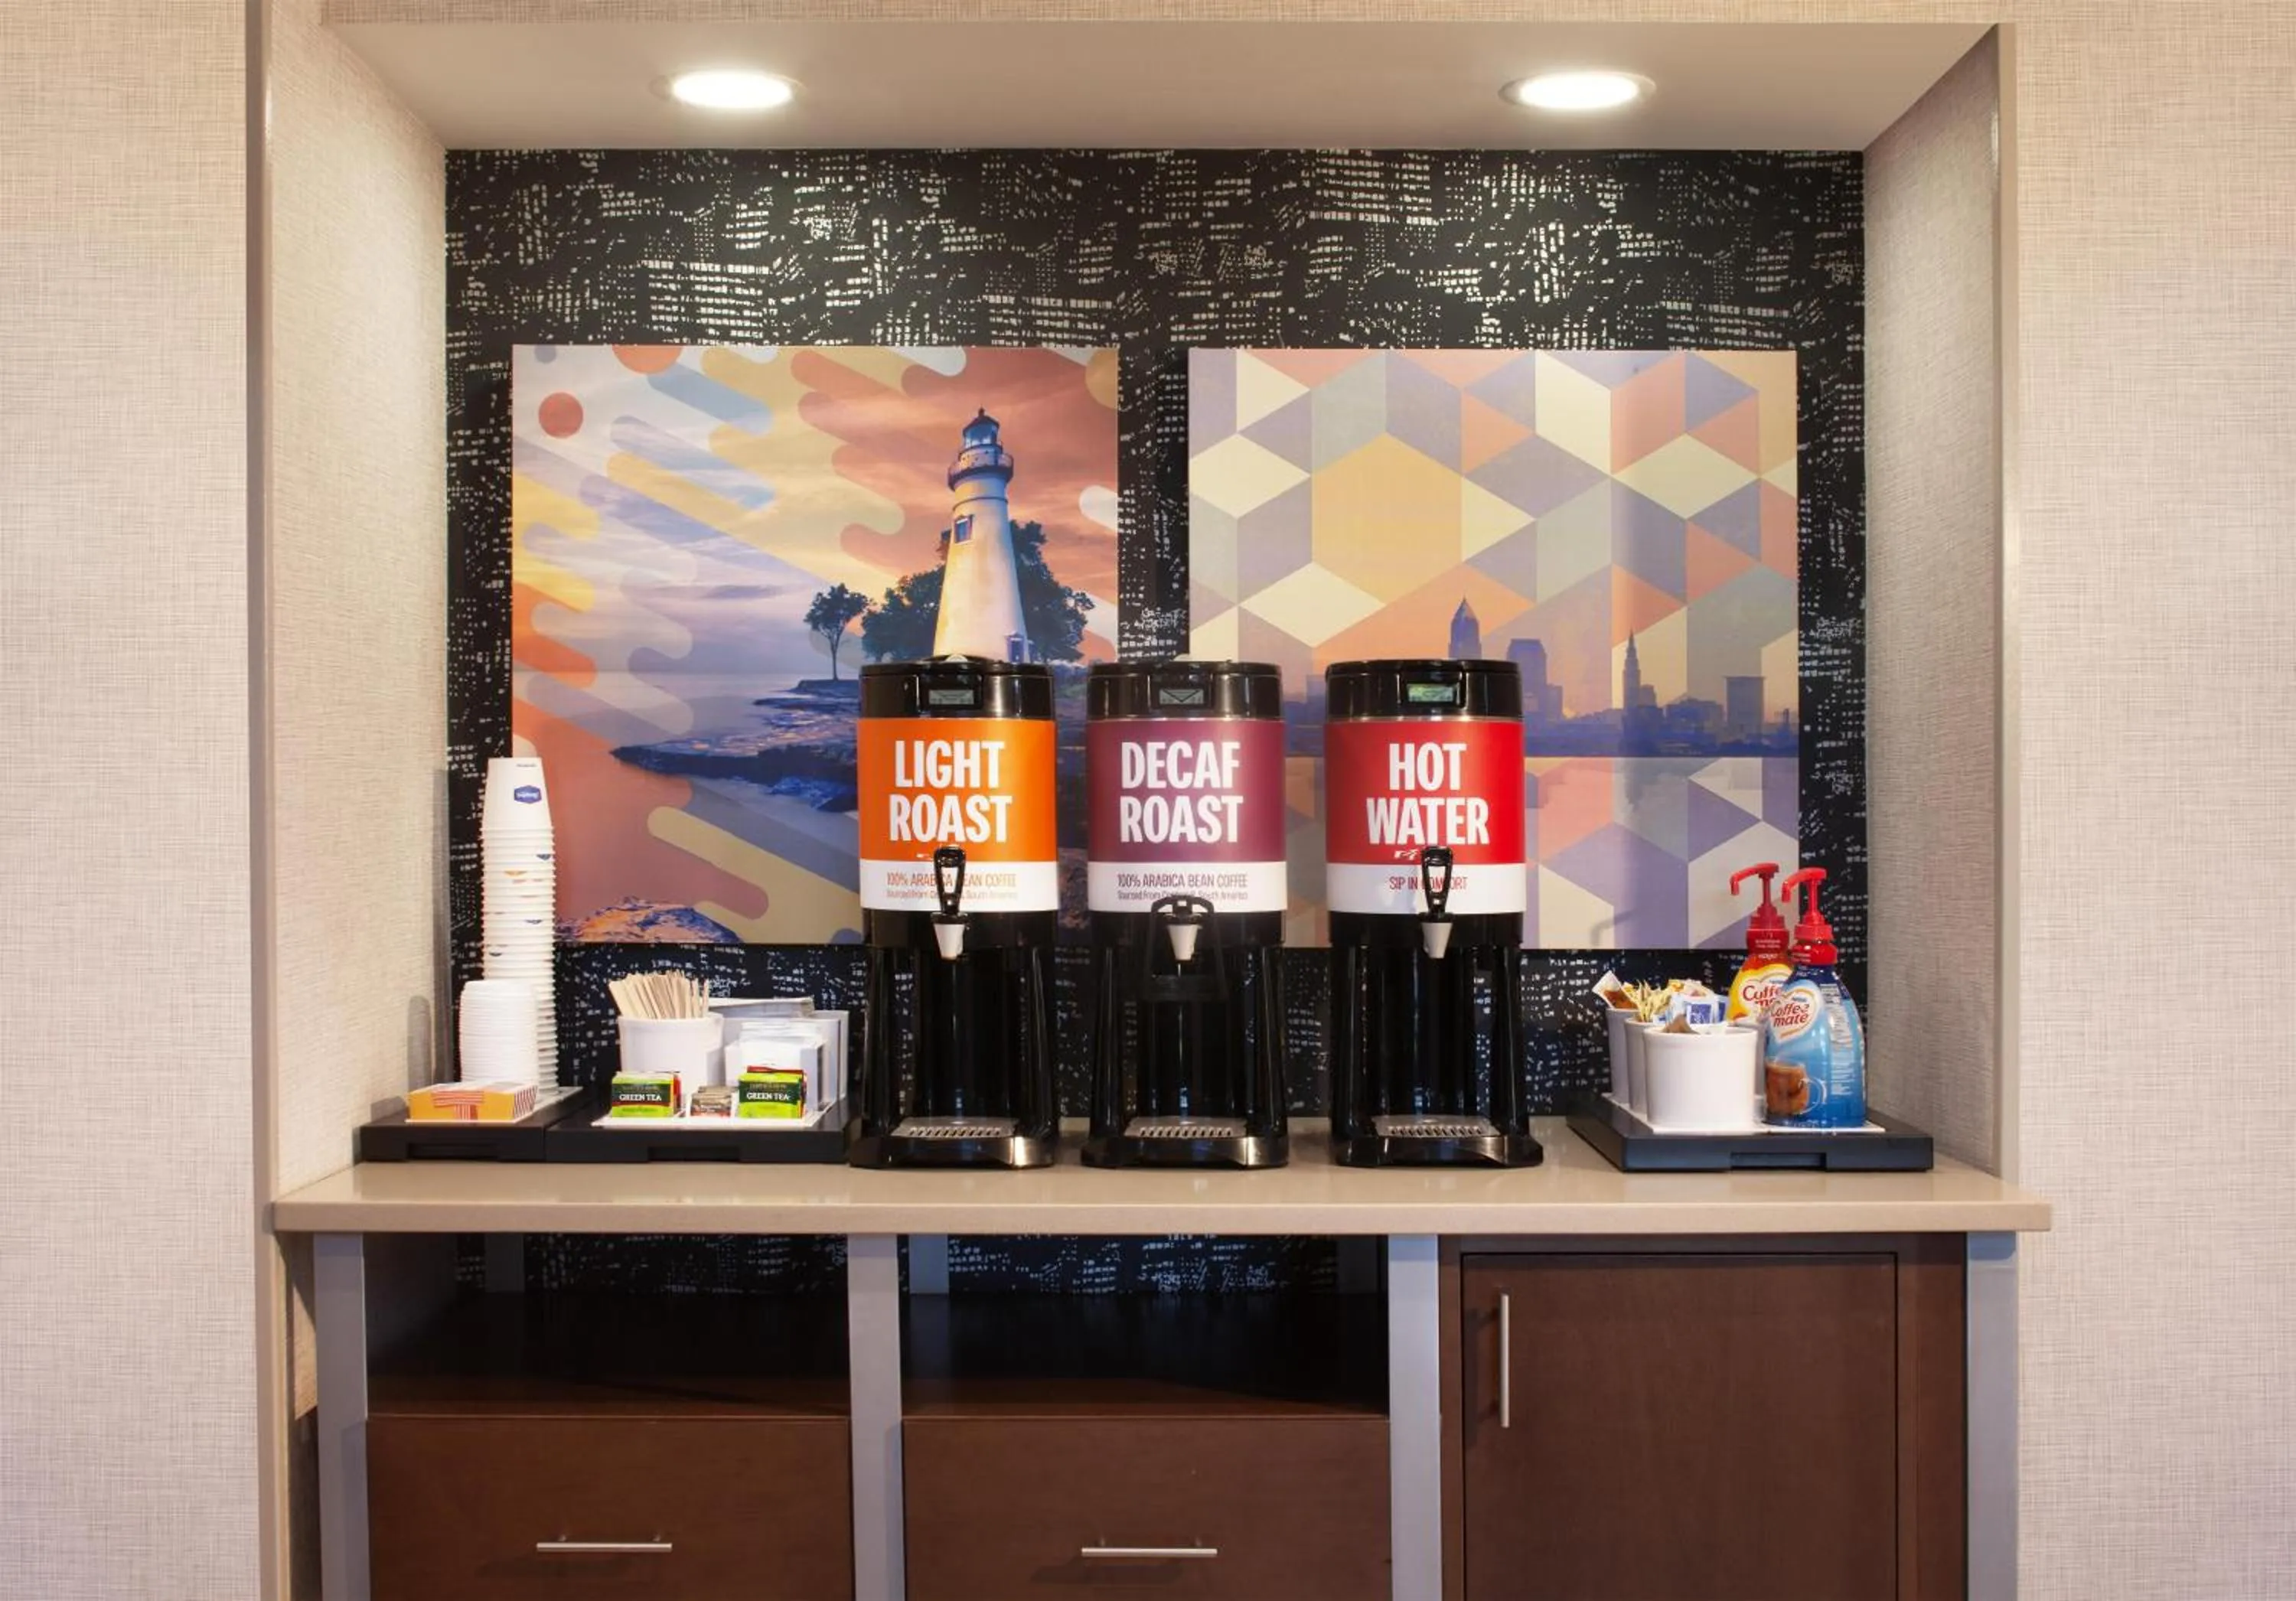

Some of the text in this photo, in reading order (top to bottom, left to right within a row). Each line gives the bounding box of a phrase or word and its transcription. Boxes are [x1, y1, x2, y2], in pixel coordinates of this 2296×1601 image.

[895, 739, 1004, 788] LIGHT
[1121, 741, 1240, 789] DECAF
[1389, 742, 1466, 791] HOT
[889, 794, 1013, 843] ROAST
[1120, 794, 1243, 843] ROAST
[1366, 797, 1490, 846] WATER
[961, 872, 982, 887] EAN
[985, 873, 1016, 888] COFFEE
[1117, 872, 1248, 888] 100% ARABICA BEAN COFFEE
[1389, 876, 1405, 890] SIP
[1408, 876, 1417, 889] IN
[1773, 1014, 1808, 1026] mate
[746, 1092, 788, 1101] GREEN TEA
